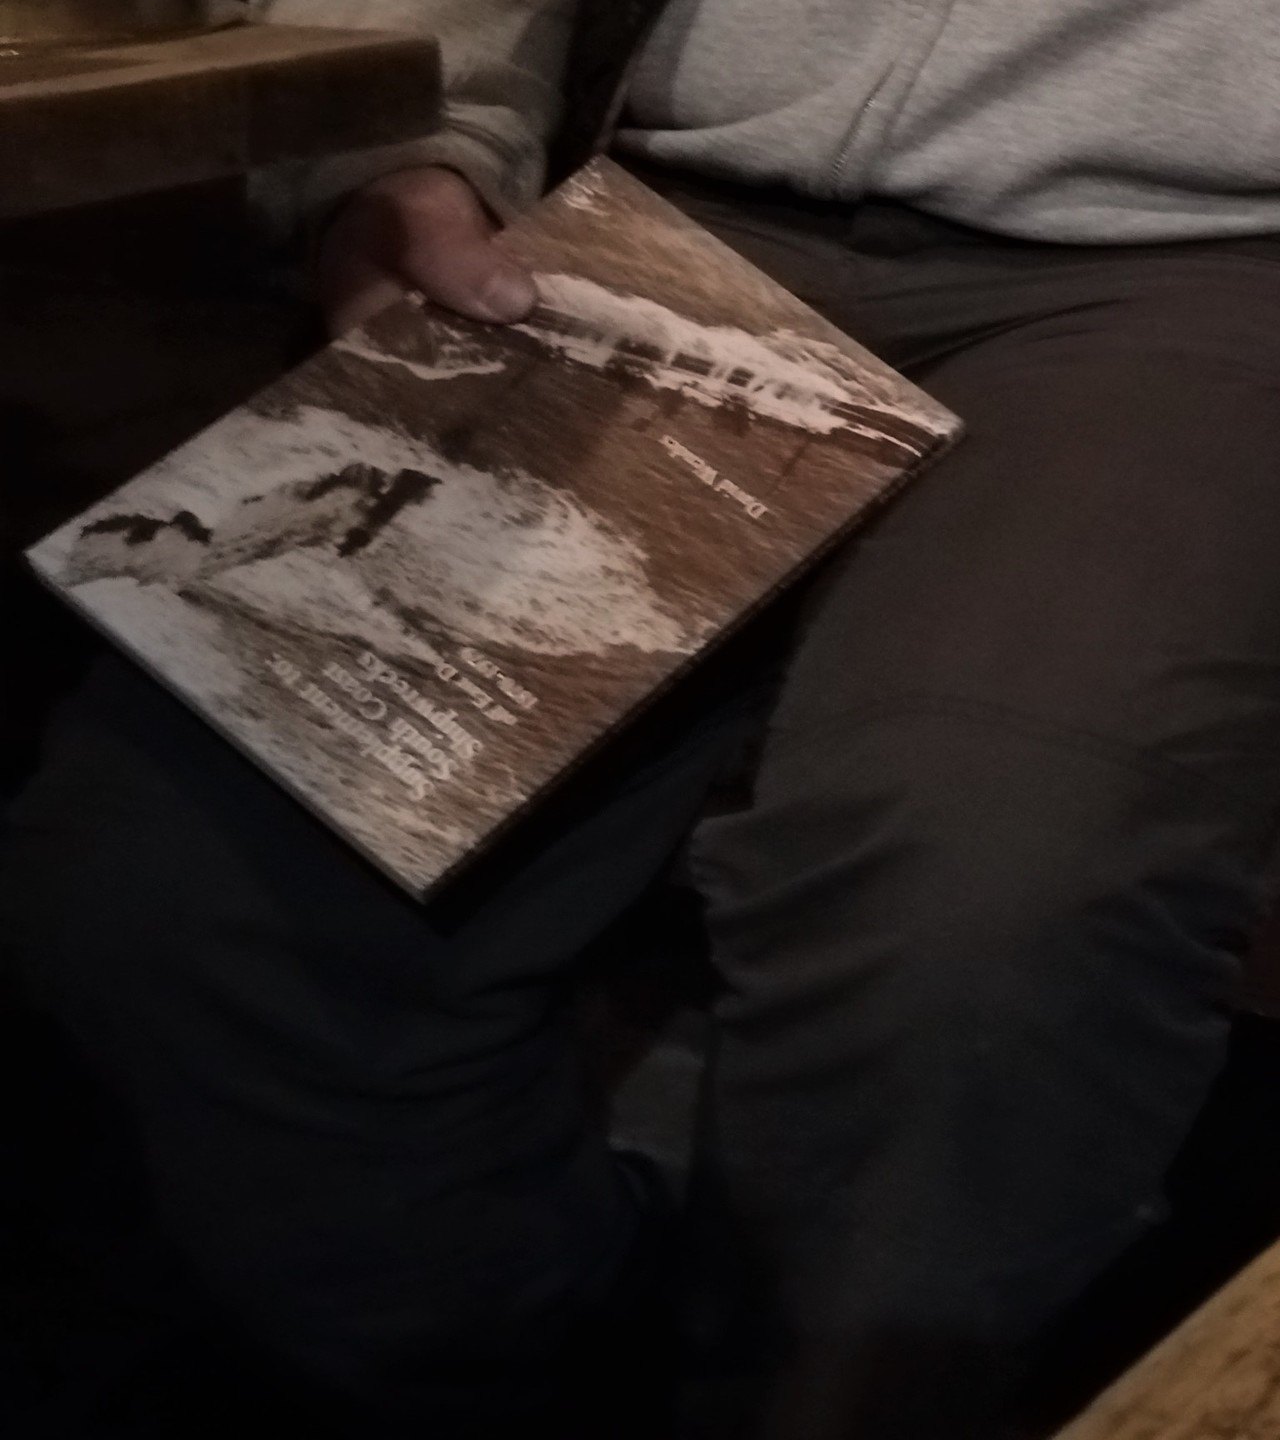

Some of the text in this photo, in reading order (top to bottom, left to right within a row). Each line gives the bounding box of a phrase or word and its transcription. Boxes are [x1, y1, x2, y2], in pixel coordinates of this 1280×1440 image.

[300, 682, 435, 801] Supplement
[321, 662, 456, 780] South Coast
[356, 650, 484, 761] Shipwrecks
